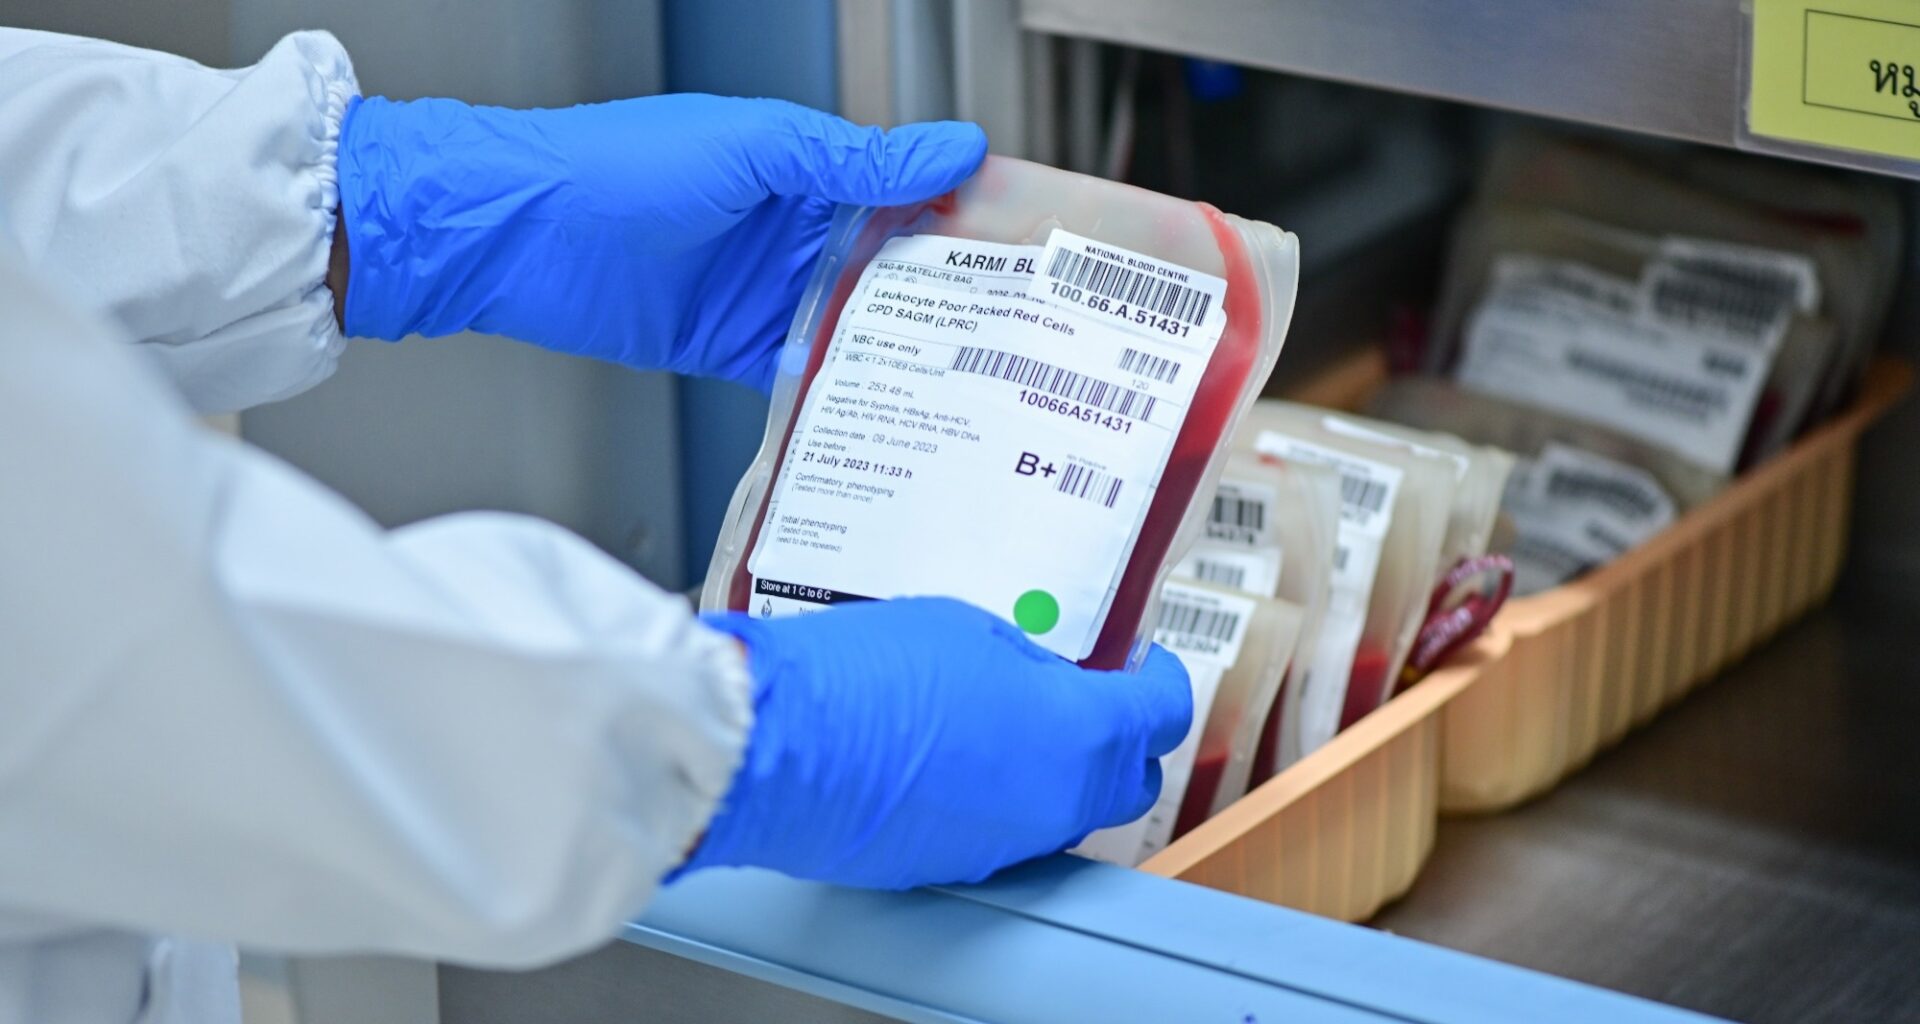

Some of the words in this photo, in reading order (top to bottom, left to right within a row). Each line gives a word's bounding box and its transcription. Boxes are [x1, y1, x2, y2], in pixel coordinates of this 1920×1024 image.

[945, 250, 1008, 272] KARMI
[1084, 245, 1125, 264] NATIONAL
[1127, 258, 1156, 272] BLOOD
[1157, 266, 1190, 284] CENTRE
[905, 265, 951, 282] SATELLITE
[953, 274, 974, 285] BAG
[866, 303, 893, 316] CPD
[895, 308, 934, 324] SAGM
[935, 315, 979, 334] (LPRC)
[874, 287, 936, 309] Leukocyte
[938, 300, 969, 313] Poor
[969, 302, 1011, 319] Packed
[1013, 308, 1041, 324] Red
[1042, 315, 1076, 336] Cells
[1050, 280, 1190, 338] 100.66.A.51431
[851, 333, 876, 345] NBC
[876, 339, 896, 350] use
[897, 343, 922, 357] only
[1131, 378, 1150, 391] 120
[826, 394, 858, 407] Negative
[858, 397, 869, 407] for
[1019, 389, 1133, 435] 10066A51431
[813, 424, 849, 438] Collection
[872, 432, 886, 445] 09
[887, 436, 911, 449] June
[912, 440, 938, 454] 2023
[899, 418, 918, 429] HCV
[961, 430, 981, 443] DNA
[807, 439, 822, 449] Use
[802, 451, 815, 462] 21
[817, 453, 841, 469] July
[843, 457, 870, 472] 2023
[873, 463, 903, 478] 11:33
[904, 469, 913, 480] h
[1014, 450, 1057, 479] B+
[795, 472, 843, 488] Confirmatory
[846, 480, 894, 498] phenotyping
[800, 517, 848, 535] phenotyping
[760, 579, 781, 593] Store
[782, 584, 791, 595] at
[798, 586, 806, 596] C
[807, 587, 816, 598] to
[816, 588, 823, 599] 6
[824, 590, 832, 601] C
